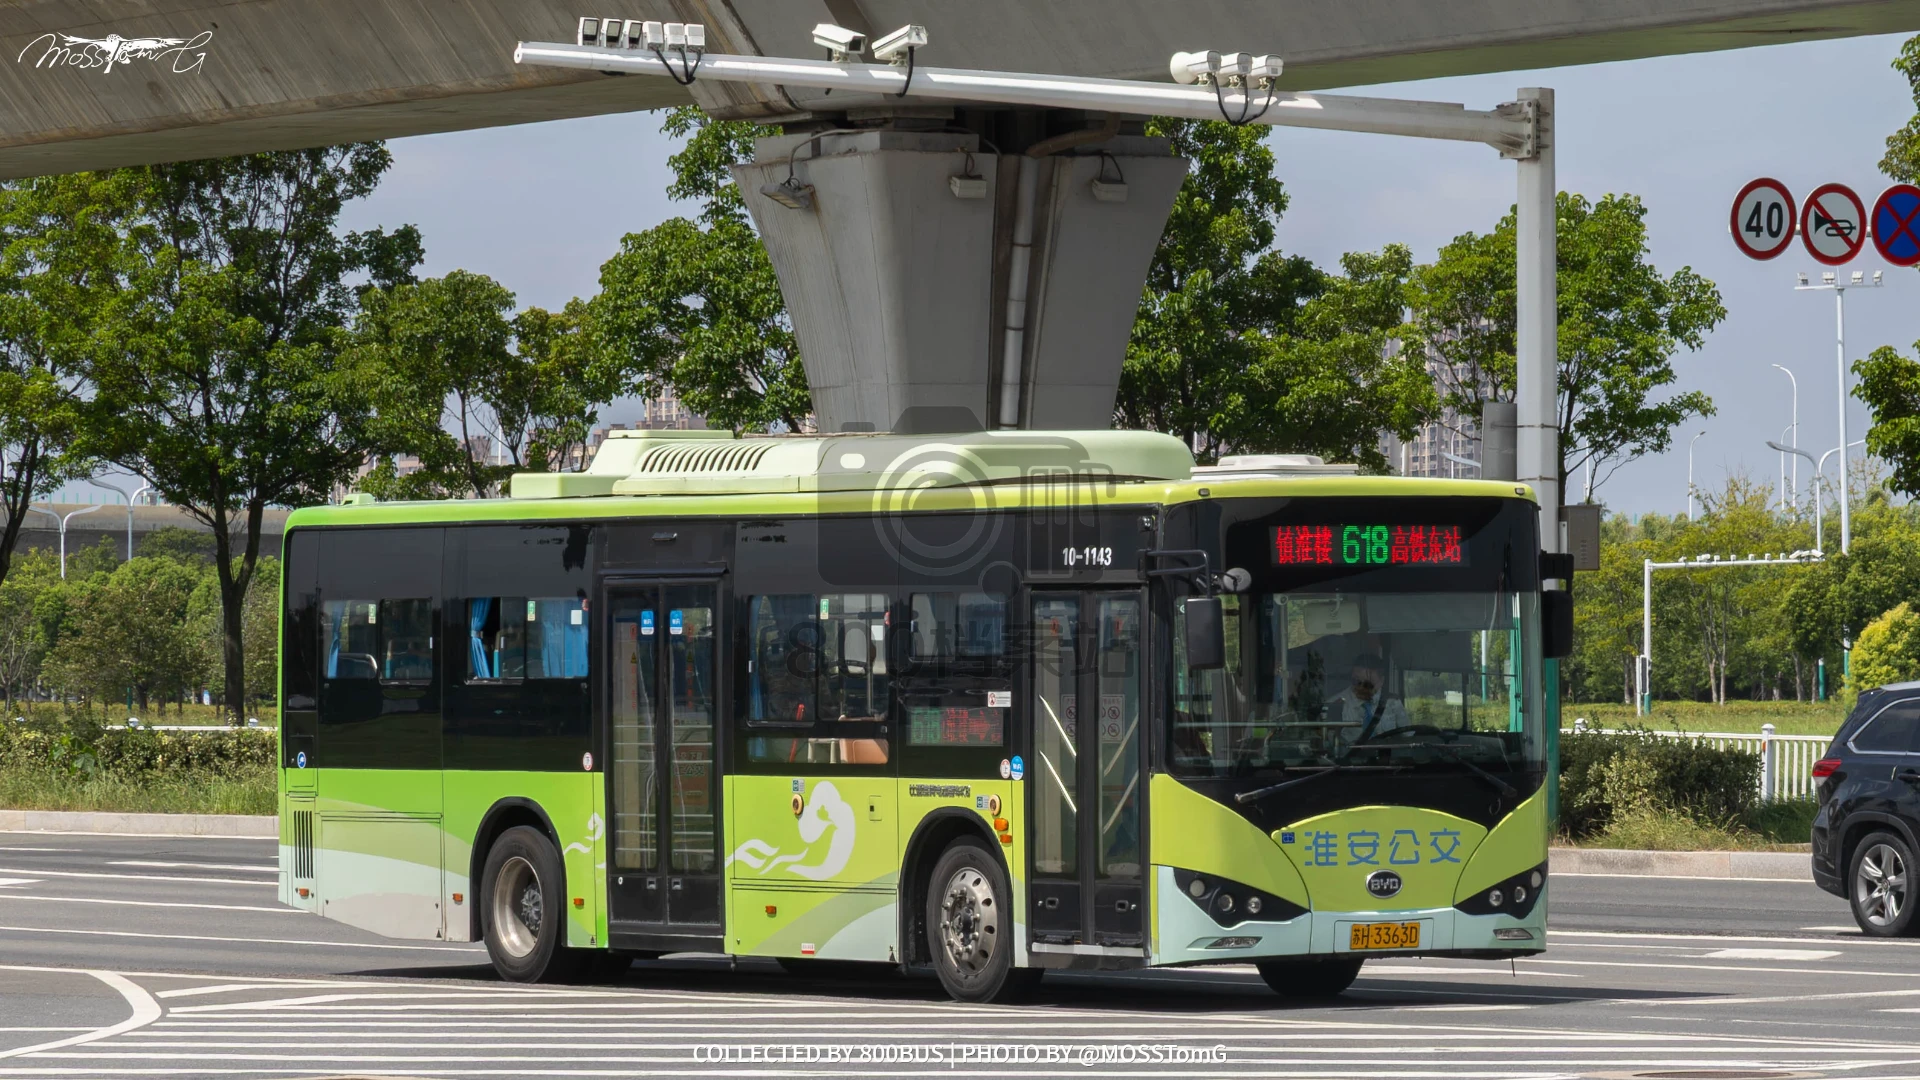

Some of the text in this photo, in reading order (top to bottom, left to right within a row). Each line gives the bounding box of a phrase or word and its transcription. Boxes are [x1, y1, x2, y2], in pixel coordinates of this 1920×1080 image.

[1745, 201, 1784, 238] 40
[1062, 547, 1112, 566] 10-1143
[1342, 525, 1389, 564] 618
[1391, 525, 1462, 564] 高铁东站
[1304, 828, 1461, 867] 淮安公交
[1370, 879, 1399, 891] BYD
